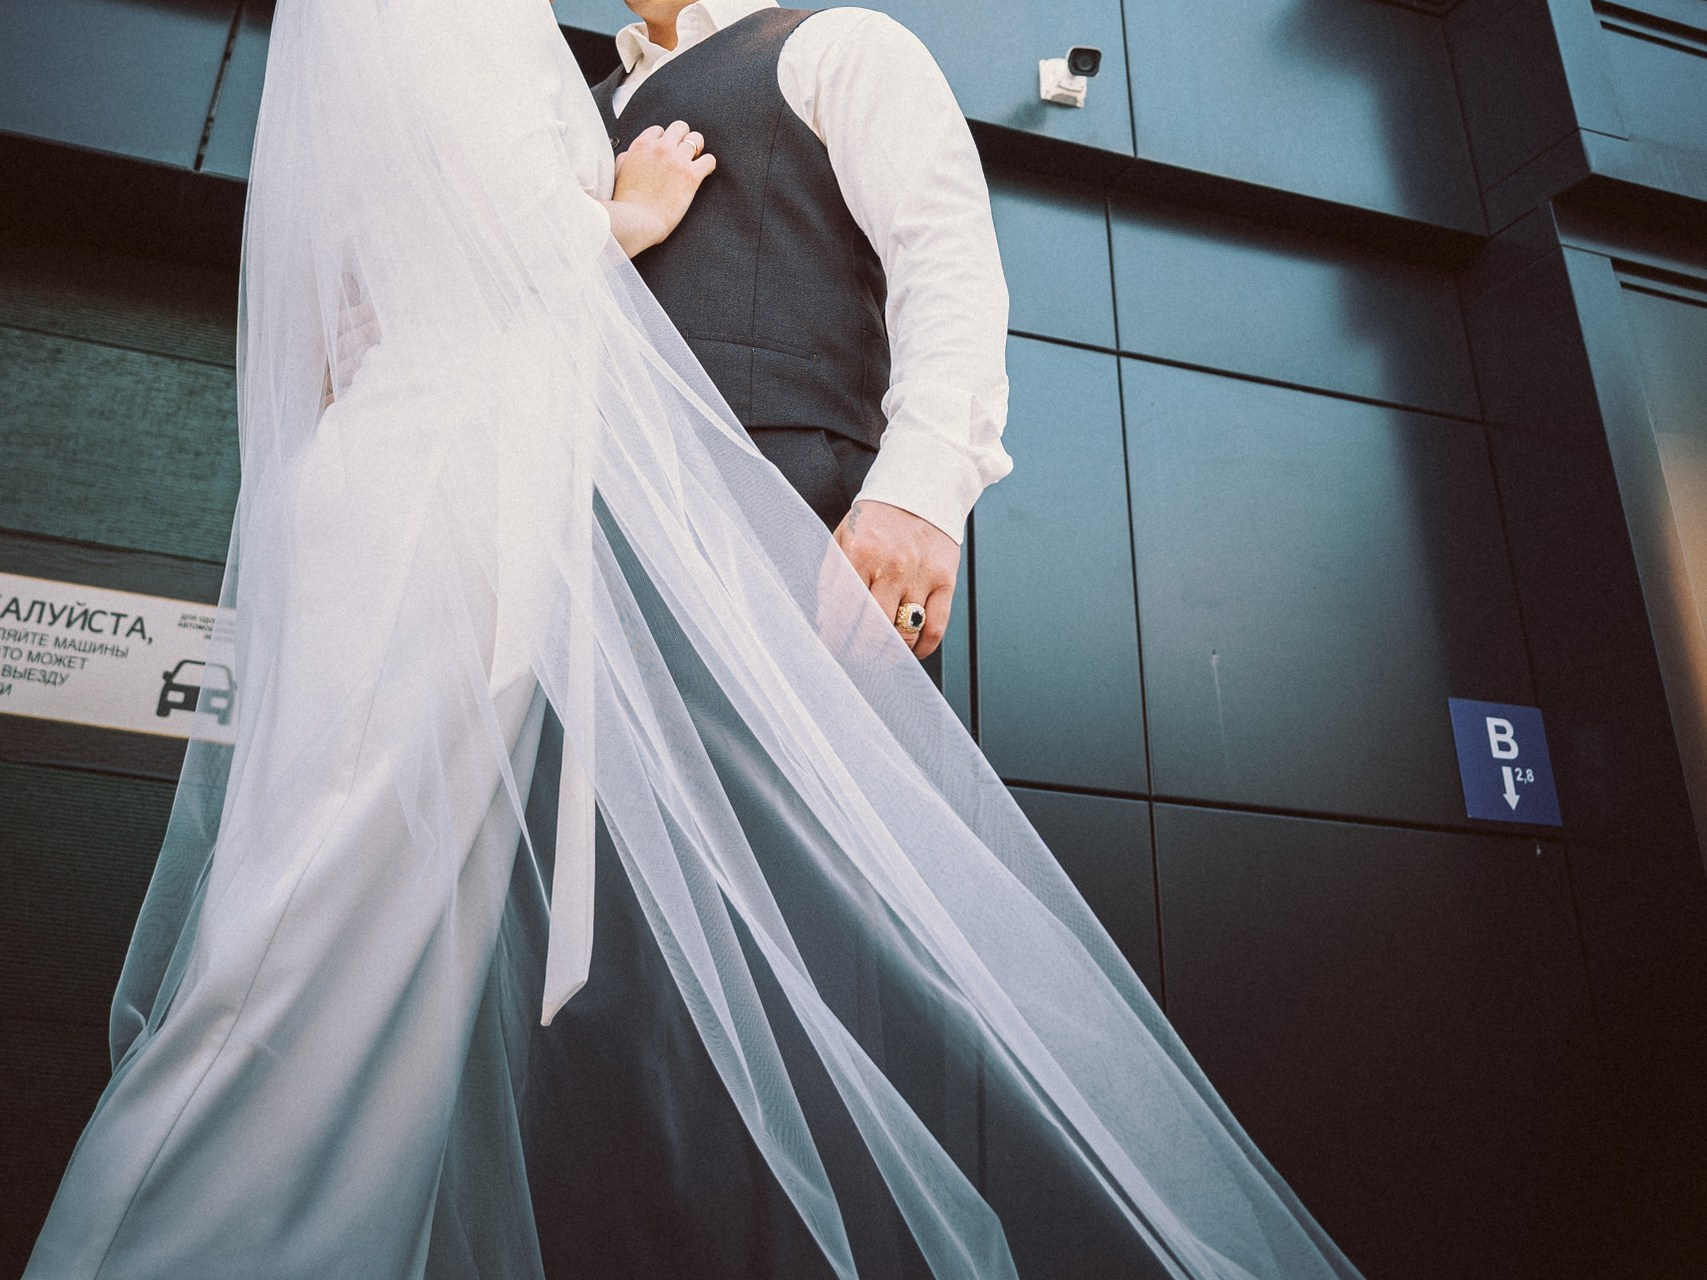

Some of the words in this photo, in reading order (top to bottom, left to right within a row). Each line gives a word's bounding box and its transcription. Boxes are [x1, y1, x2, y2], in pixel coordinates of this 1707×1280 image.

[0, 594, 153, 645] АЛУЙСТА,
[0, 645, 23, 662] ТО
[27, 651, 88, 670] МОЖЕТ
[53, 638, 130, 659] МАШИНЫ
[1, 663, 70, 686] ВЫЕЗДУ
[1514, 767, 1535, 785] 2,8
